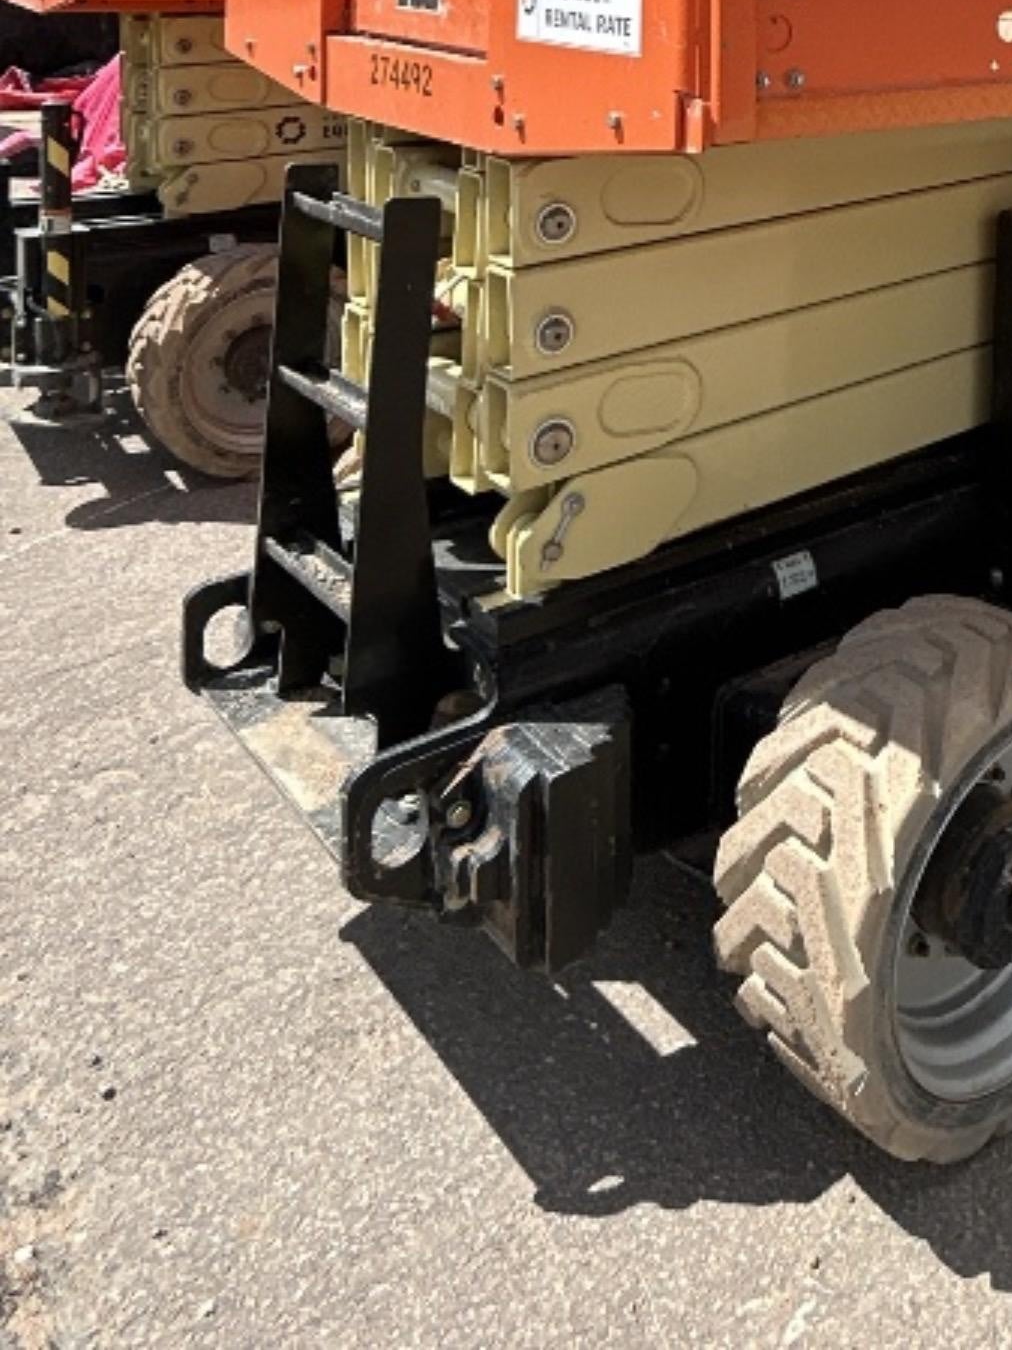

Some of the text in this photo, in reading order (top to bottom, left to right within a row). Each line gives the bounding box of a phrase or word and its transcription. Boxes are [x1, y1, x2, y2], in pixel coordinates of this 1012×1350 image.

[544, 8, 632, 37] RENTAL RATE
[370, 53, 433, 97] 274492
